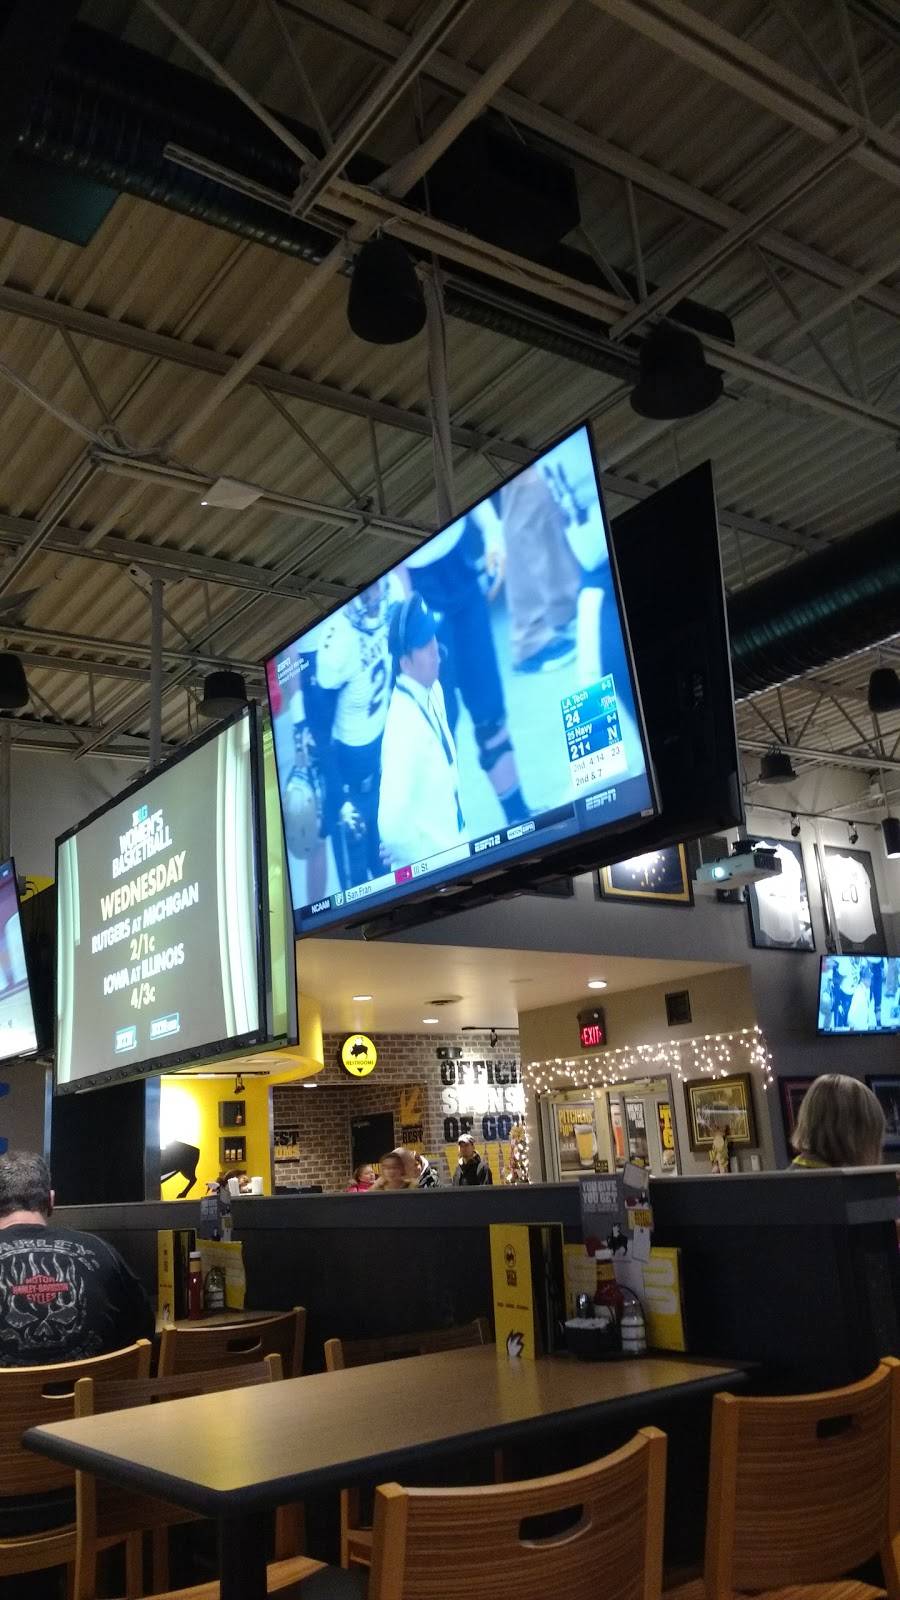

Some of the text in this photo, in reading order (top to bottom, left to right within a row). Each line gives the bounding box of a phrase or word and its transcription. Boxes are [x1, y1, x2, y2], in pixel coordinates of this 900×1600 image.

[573, 690, 589, 704] Tech
[565, 709, 580, 729] 24
[575, 722, 593, 737] Navy
[570, 742, 585, 761] 21
[576, 773, 589, 787] 2nd
[585, 788, 617, 811] ESPN
[119, 809, 164, 855] WOMEN'S
[112, 825, 173, 879] BASKETBALL
[100, 850, 187, 921] WEDNESDAY
[311, 899, 330, 914] NCAAM
[347, 891, 359, 901] San
[359, 885, 372, 897] Fran
[92, 882, 199, 954] RUTGERS AT MICHIGAN
[129, 933, 155, 961] 2/1c
[103, 942, 185, 996] IOWA AT ILLINOIS
[130, 982, 156, 1009] 4/3c
[583, 1025, 600, 1045] EXIT
[440, 1059, 522, 1085] OFFICI
[273, 1131, 299, 1146] EST
[443, 1115, 474, 1143] OF
[582, 1180, 617, 1192] YOU GIVE
[582, 1192, 598, 1204] YOU
[0, 1239, 96, 1258] ARLEY
[25, 1275, 56, 1284] MOTOR
[26, 1292, 56, 1303] CYCLES
